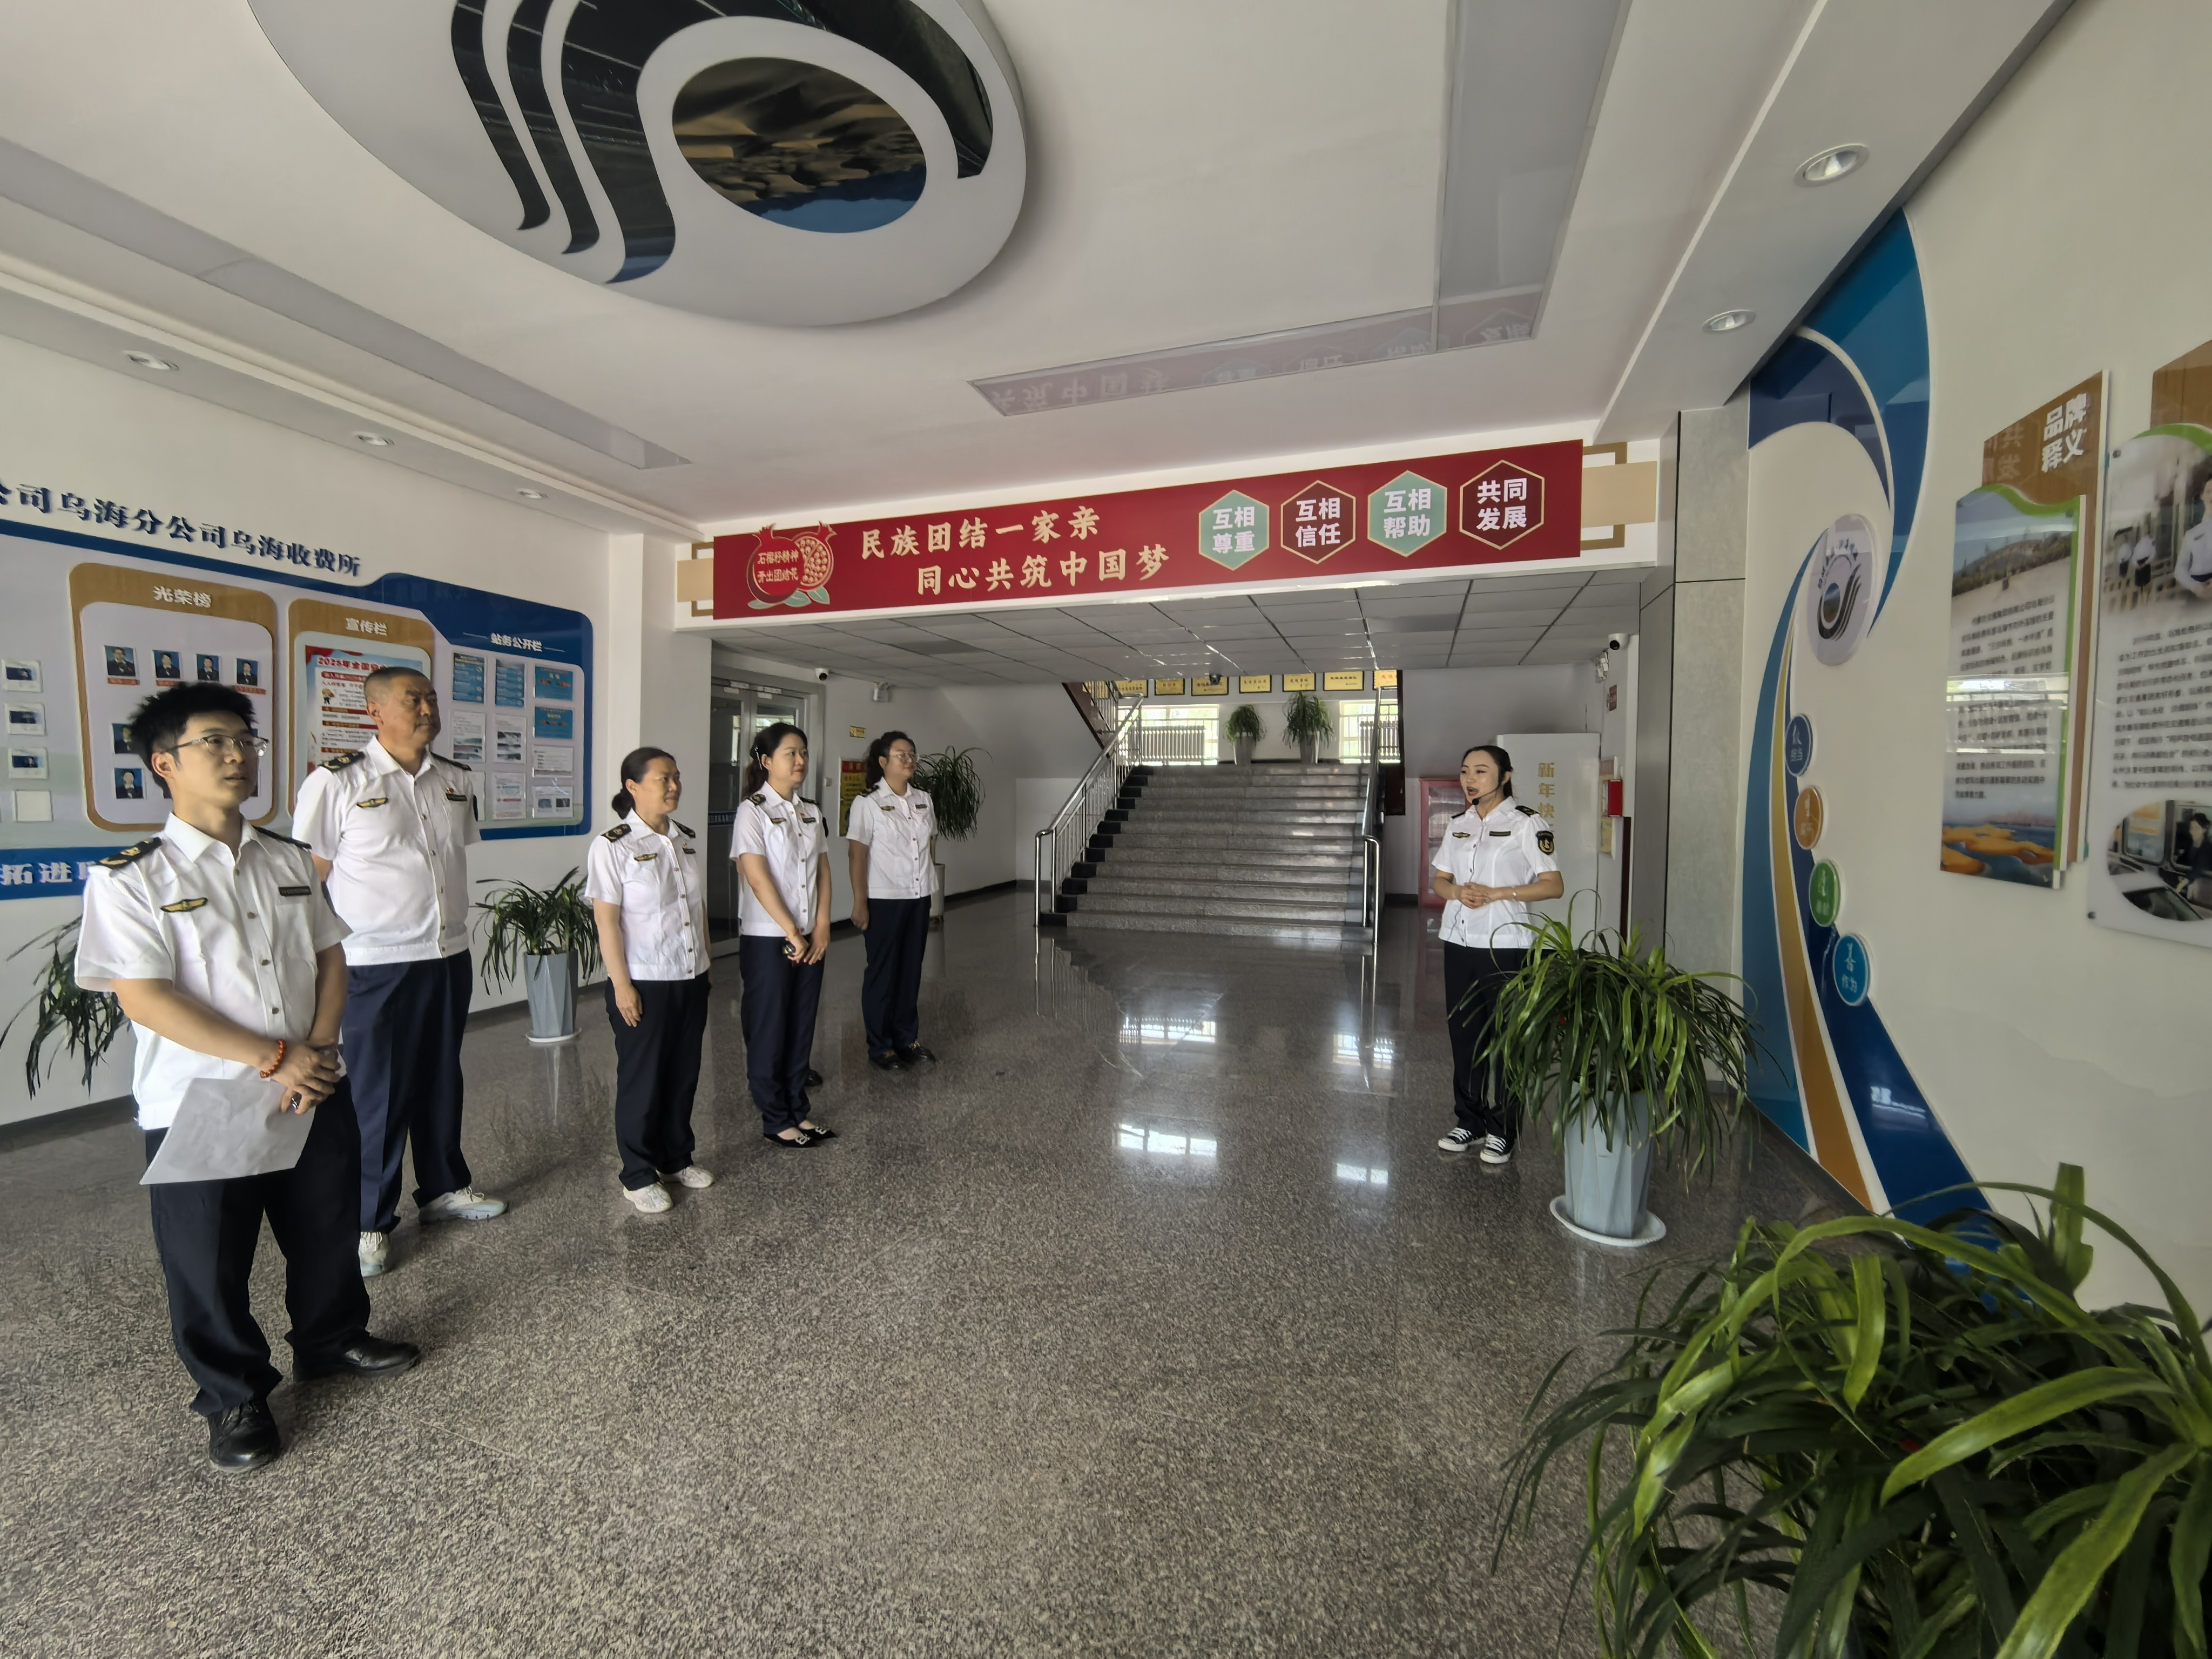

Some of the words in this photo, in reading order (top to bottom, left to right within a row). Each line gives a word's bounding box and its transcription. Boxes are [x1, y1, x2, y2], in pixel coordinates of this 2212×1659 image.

[2044, 393, 2087, 441] 品牌
[2041, 428, 2087, 473] 释义
[1384, 488, 1432, 513] 互相
[1476, 478, 1528, 503] 共同
[1213, 507, 1255, 529] 互相
[1296, 497, 1340, 522] 互相
[1476, 505, 1528, 532] 发展
[861, 505, 1101, 559] 民族团结一家亲
[1296, 523, 1340, 548] 信任
[1383, 514, 1431, 539] 帮助
[1212, 531, 1256, 555] 尊重
[758, 549, 799, 564] 石榴籽精神
[757, 567, 799, 583] 开出团结花
[917, 544, 1169, 595] 同心共筑中国梦
[153, 585, 211, 608] 光荣榜
[346, 618, 388, 636] 宣传栏
[1538, 763, 1555, 833] 新年快
